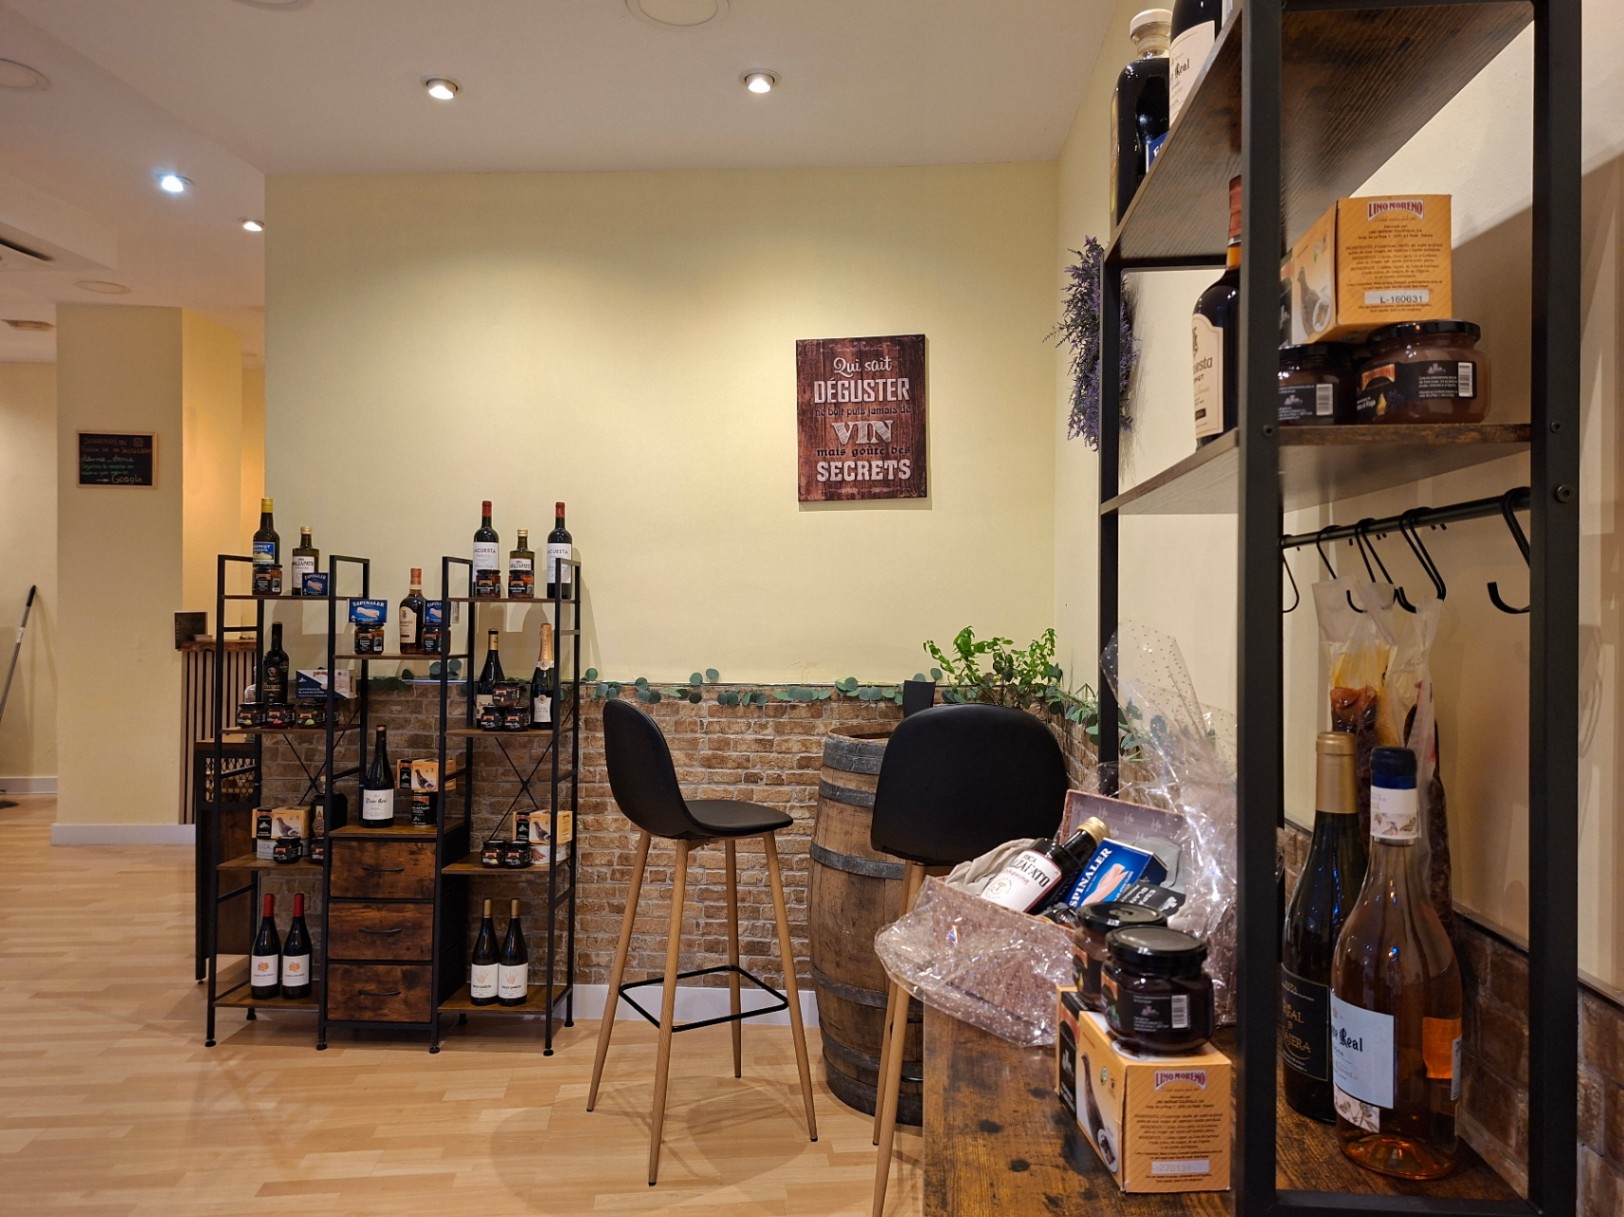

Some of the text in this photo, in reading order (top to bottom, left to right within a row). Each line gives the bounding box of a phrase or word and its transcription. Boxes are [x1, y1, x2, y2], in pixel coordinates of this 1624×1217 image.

[1368, 201, 1423, 218] LINO MORENO
[833, 356, 892, 377] Qui sait
[814, 377, 911, 403] DÉGUSTER
[866, 405, 897, 417] jamais
[900, 405, 912, 414] de
[832, 420, 894, 445] VIN
[816, 447, 846, 457] mais
[851, 445, 886, 458] goûte
[816, 459, 912, 482] SECRETS
[1069, 847, 1113, 908] SPINALER
[1339, 1028, 1363, 1052] Real
[1156, 1072, 1206, 1087] LINO MORENO
